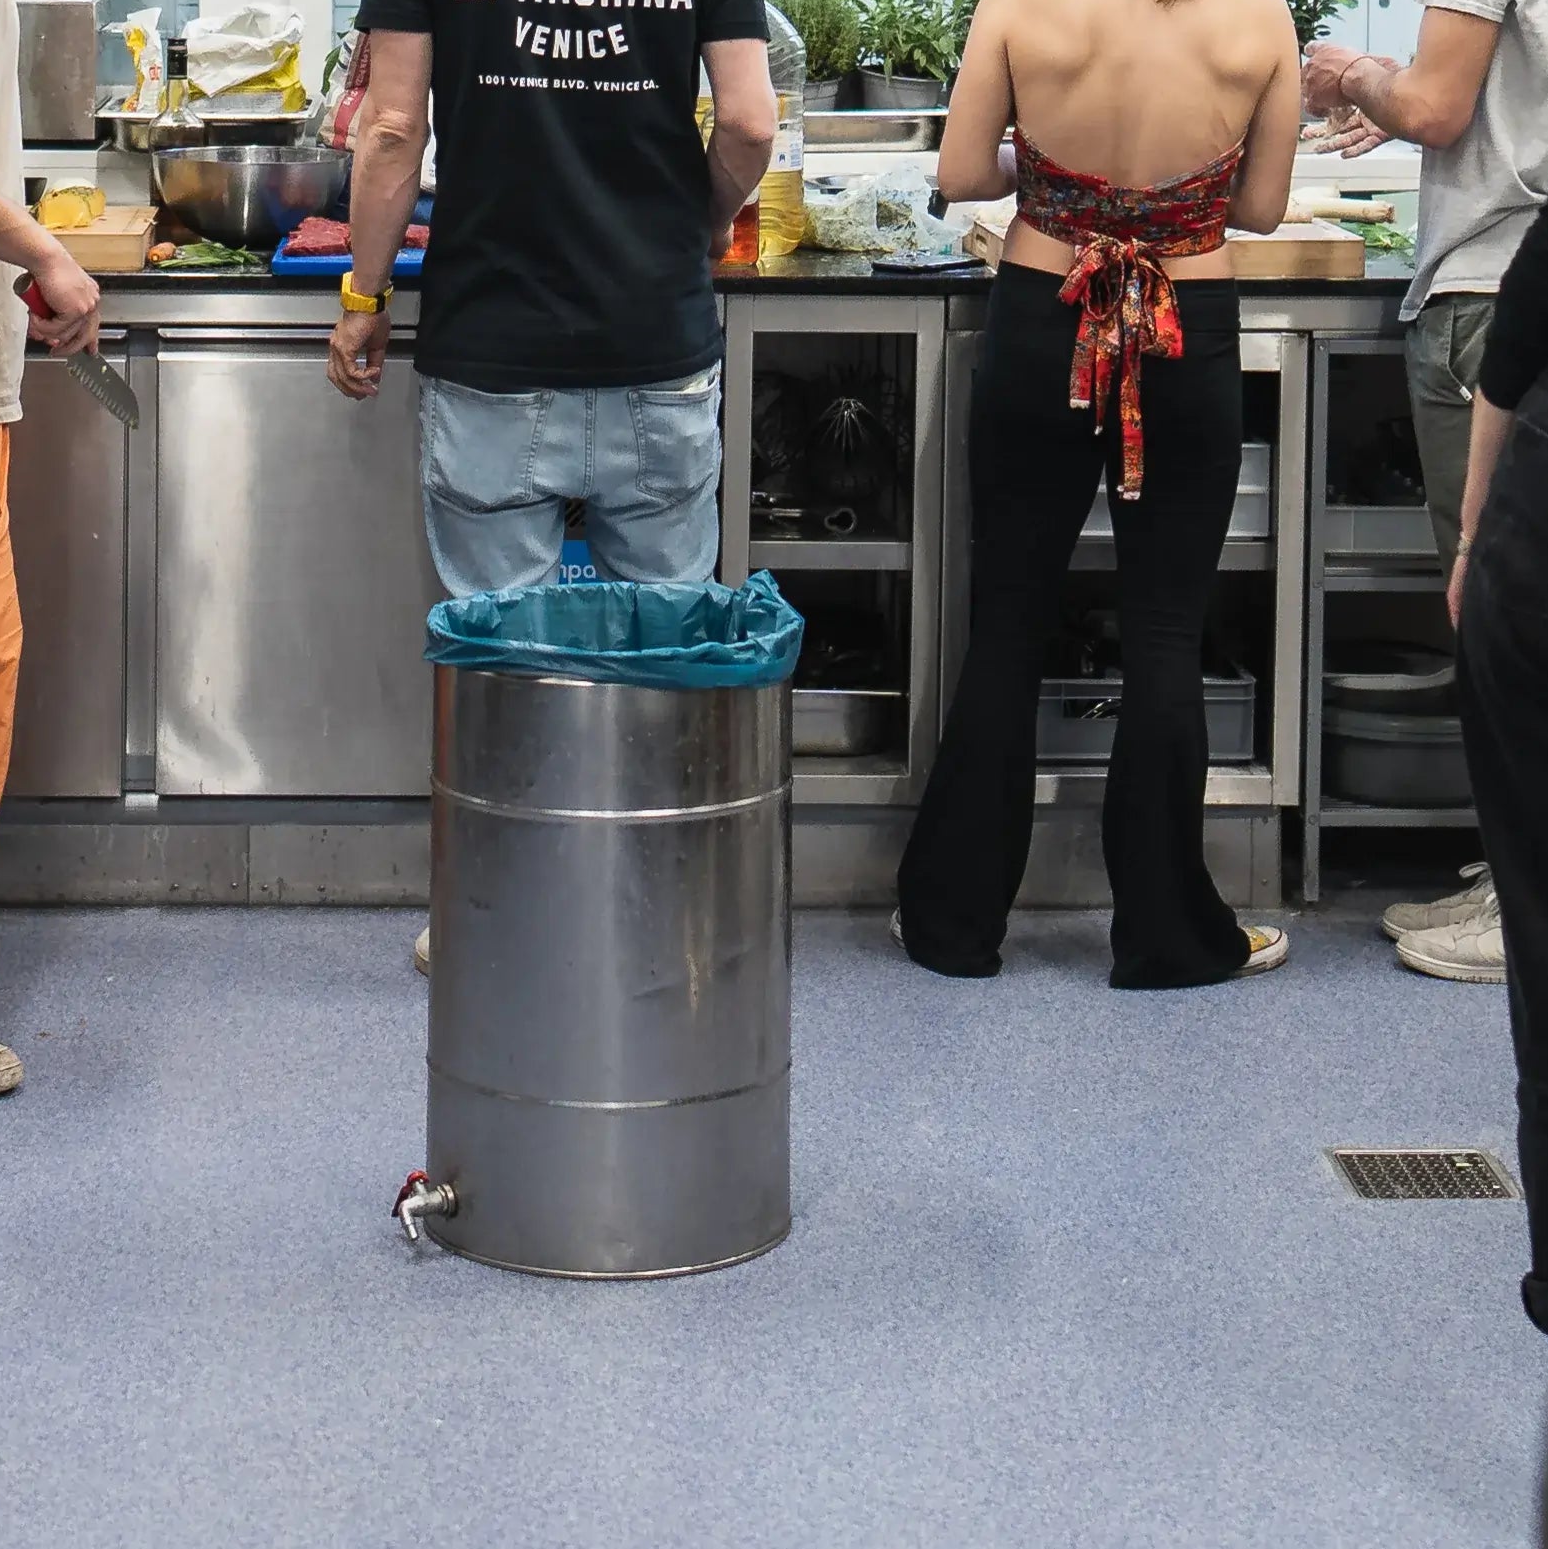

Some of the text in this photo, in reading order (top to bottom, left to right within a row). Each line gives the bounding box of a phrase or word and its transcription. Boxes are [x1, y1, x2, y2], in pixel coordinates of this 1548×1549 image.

[516, 16, 629, 59] VENICE
[479, 75, 659, 91] 1001 VENICE BLVD. VENICE CA.
